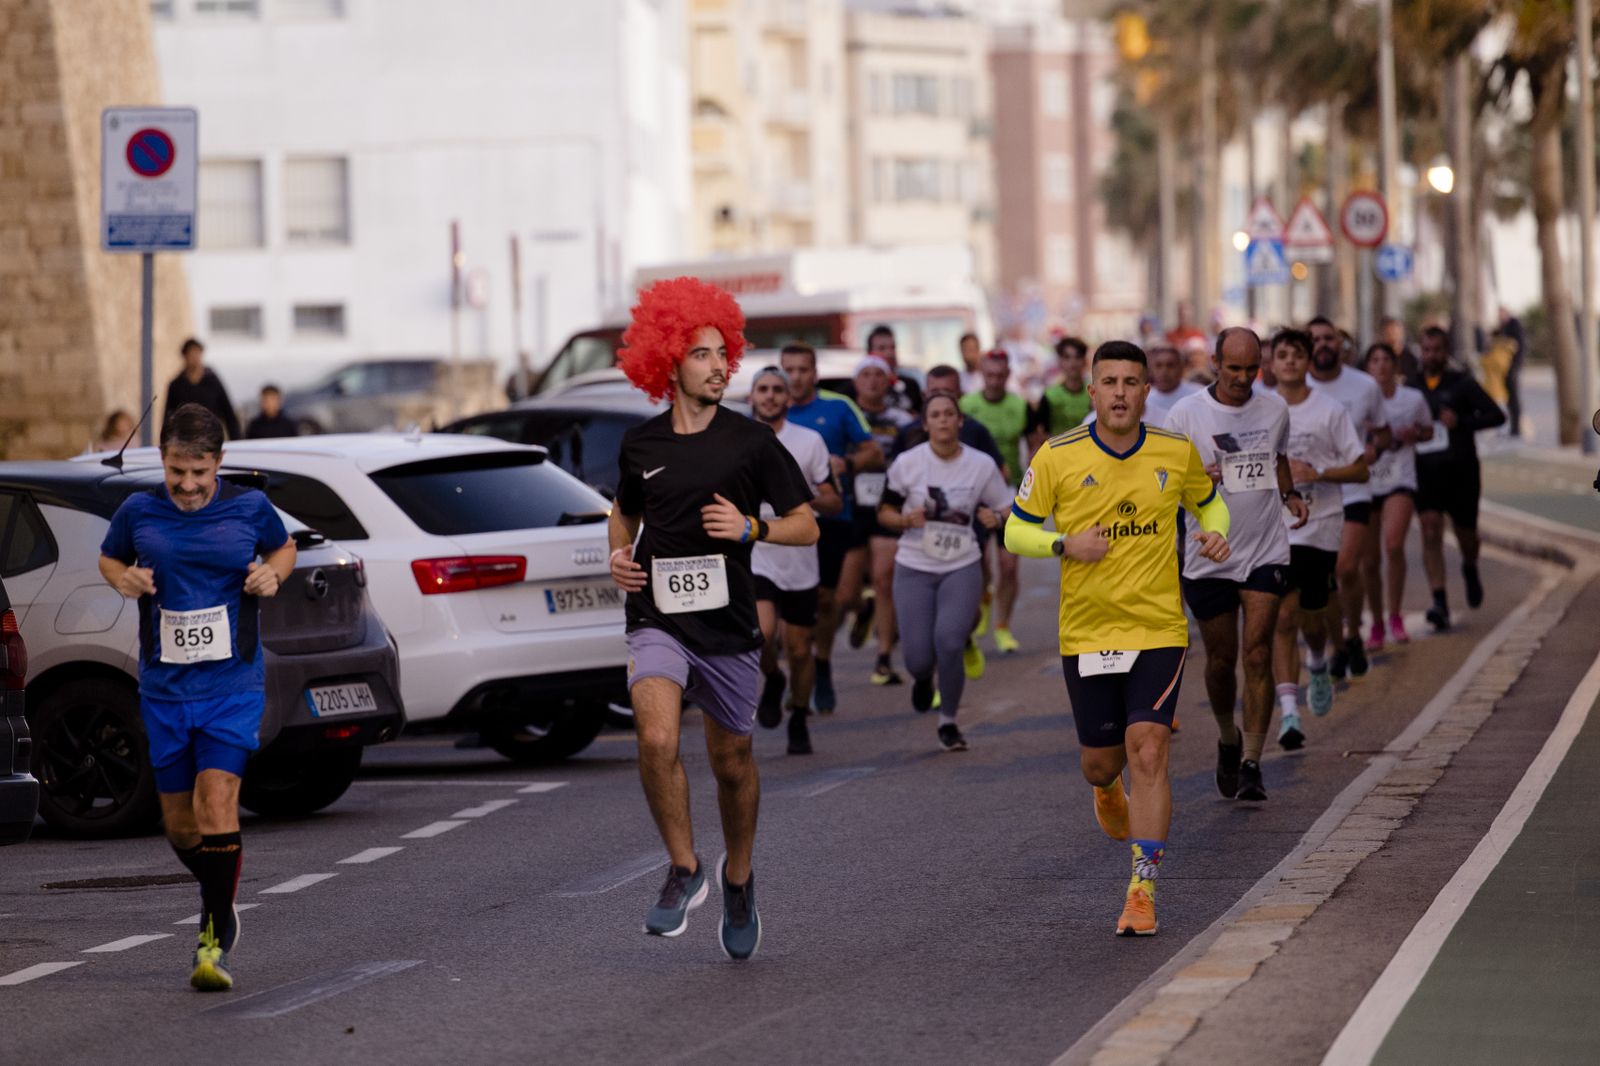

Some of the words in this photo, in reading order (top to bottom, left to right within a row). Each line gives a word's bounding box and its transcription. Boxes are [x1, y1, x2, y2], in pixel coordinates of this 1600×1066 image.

[1235, 463, 1264, 479] 722
[669, 573, 709, 593] 683
[555, 589, 594, 610] 9755
[174, 626, 213, 647] 859
[315, 688, 348, 712] 2205
